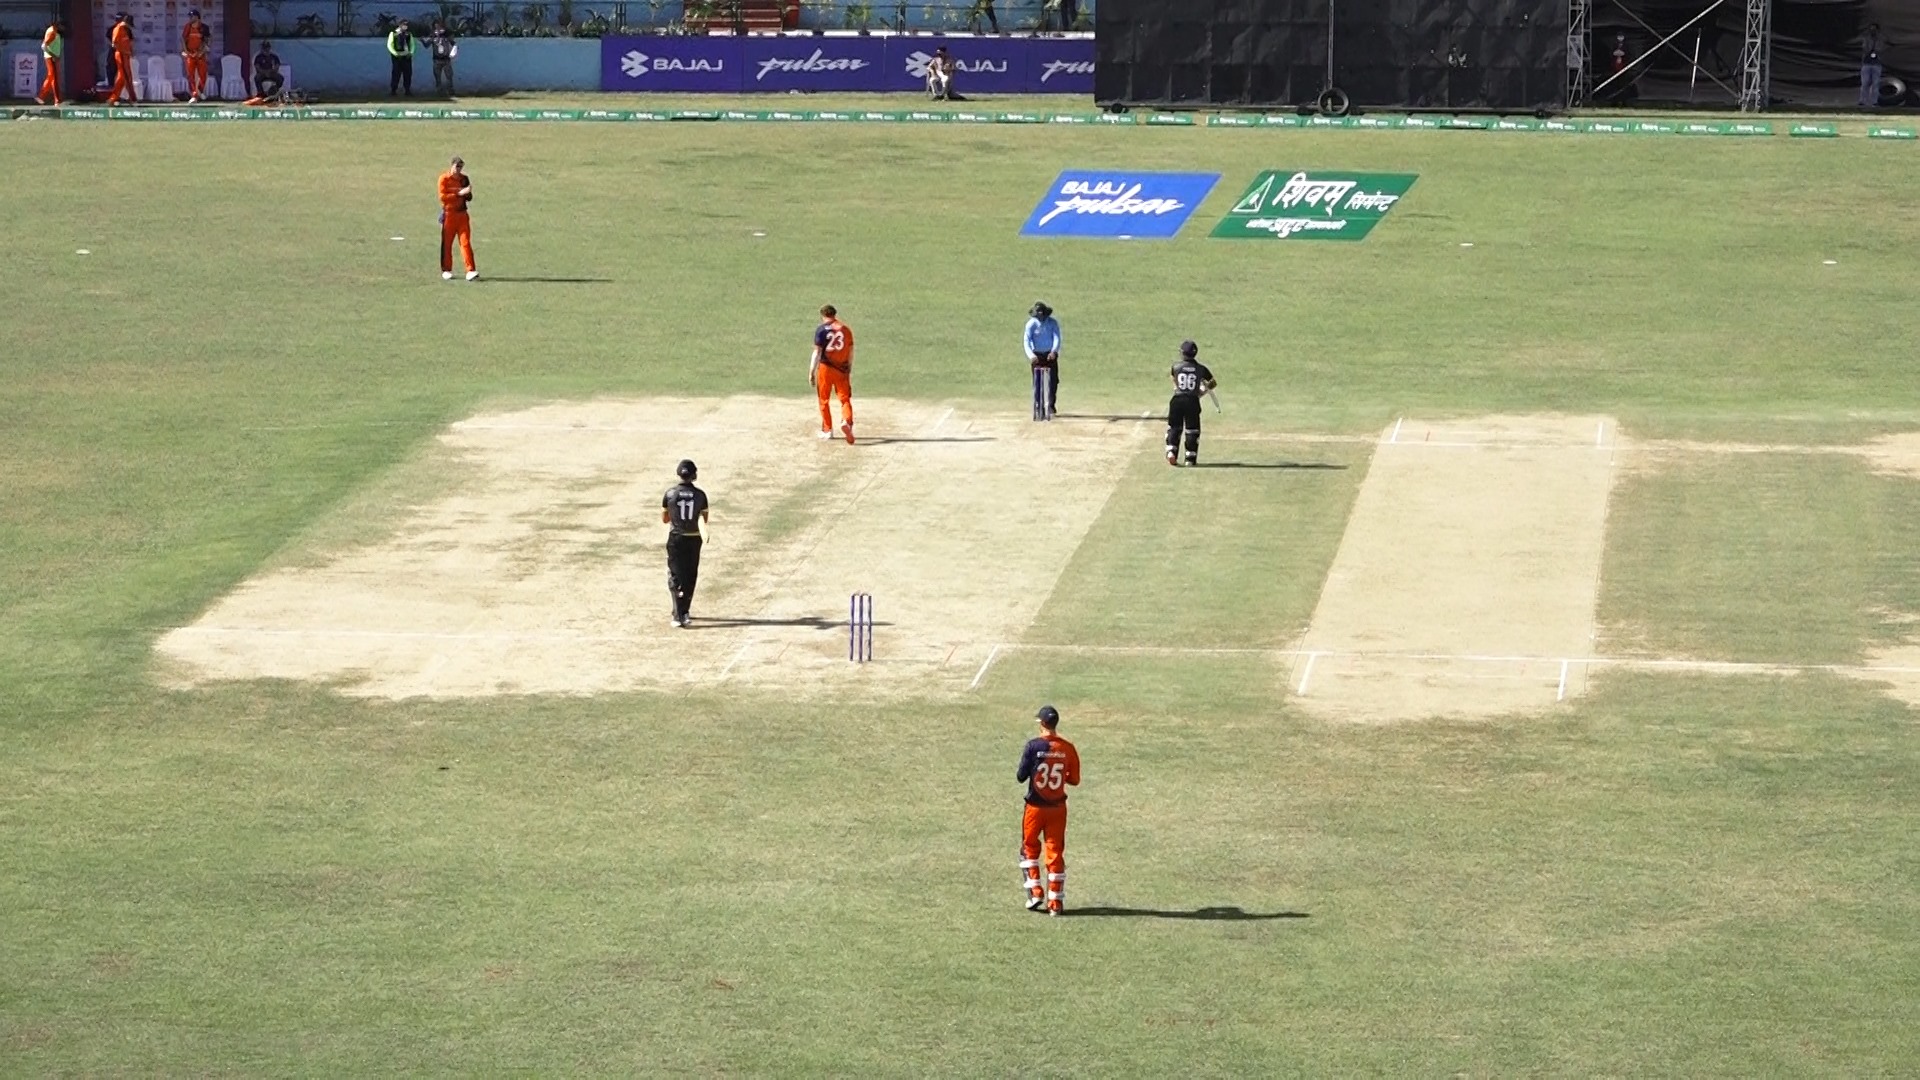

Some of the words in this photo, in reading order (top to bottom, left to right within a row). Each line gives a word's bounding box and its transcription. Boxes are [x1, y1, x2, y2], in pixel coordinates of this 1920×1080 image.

[653, 59, 724, 72] BAJAJ
[953, 60, 1008, 73] AJAJ
[1060, 181, 1127, 195] BAJAJ
[826, 331, 845, 352] 23
[1177, 372, 1197, 390] 96
[676, 500, 694, 520] 11
[1035, 763, 1065, 790] 35
